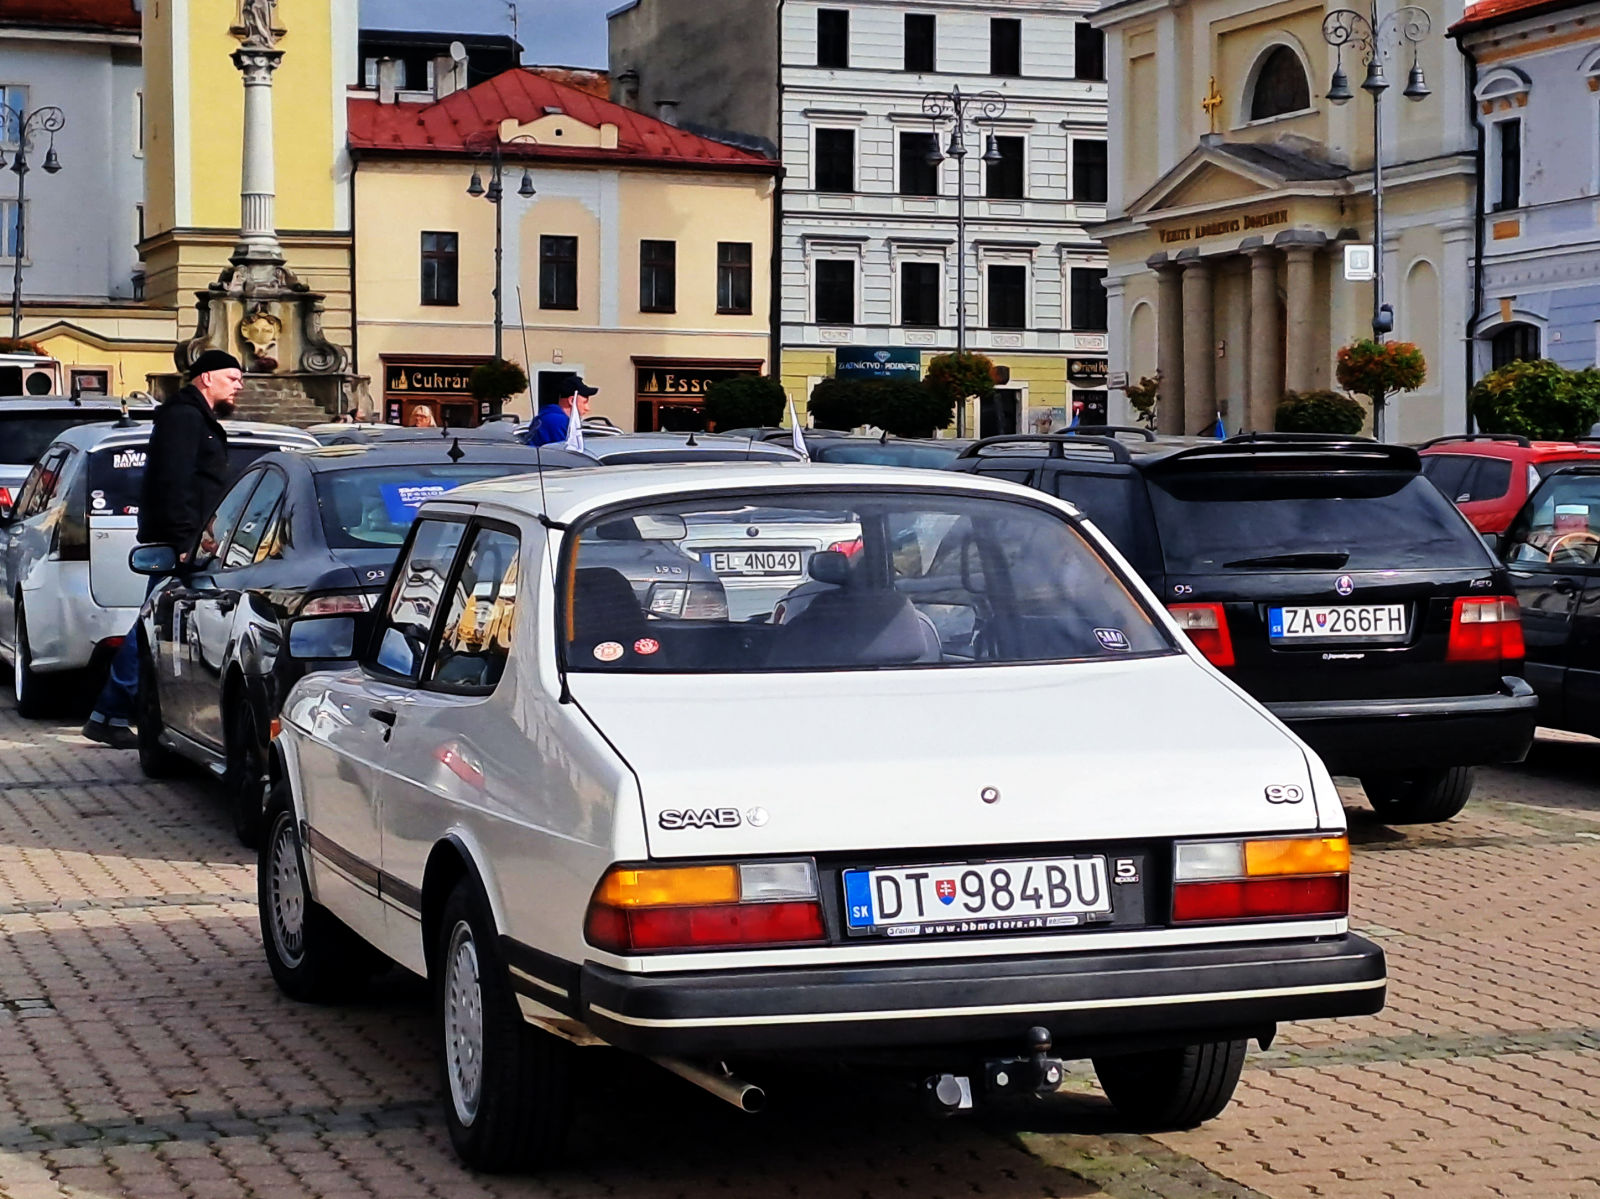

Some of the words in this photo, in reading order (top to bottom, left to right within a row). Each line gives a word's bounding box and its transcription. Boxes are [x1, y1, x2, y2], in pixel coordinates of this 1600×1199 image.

[714, 553, 737, 570] EL
[744, 552, 797, 570] 4N049
[366, 570, 385, 581] 93
[1174, 584, 1193, 596] 95
[1285, 608, 1315, 634] ZA
[1328, 606, 1402, 633] 266FH
[1264, 784, 1304, 804] 90
[659, 807, 742, 830] SAAB
[1116, 859, 1137, 877] 5
[875, 872, 930, 919] DT
[960, 862, 1101, 913] 984BU
[852, 904, 869, 918] SK
[924, 918, 1044, 934] www.bbmotors.sk
